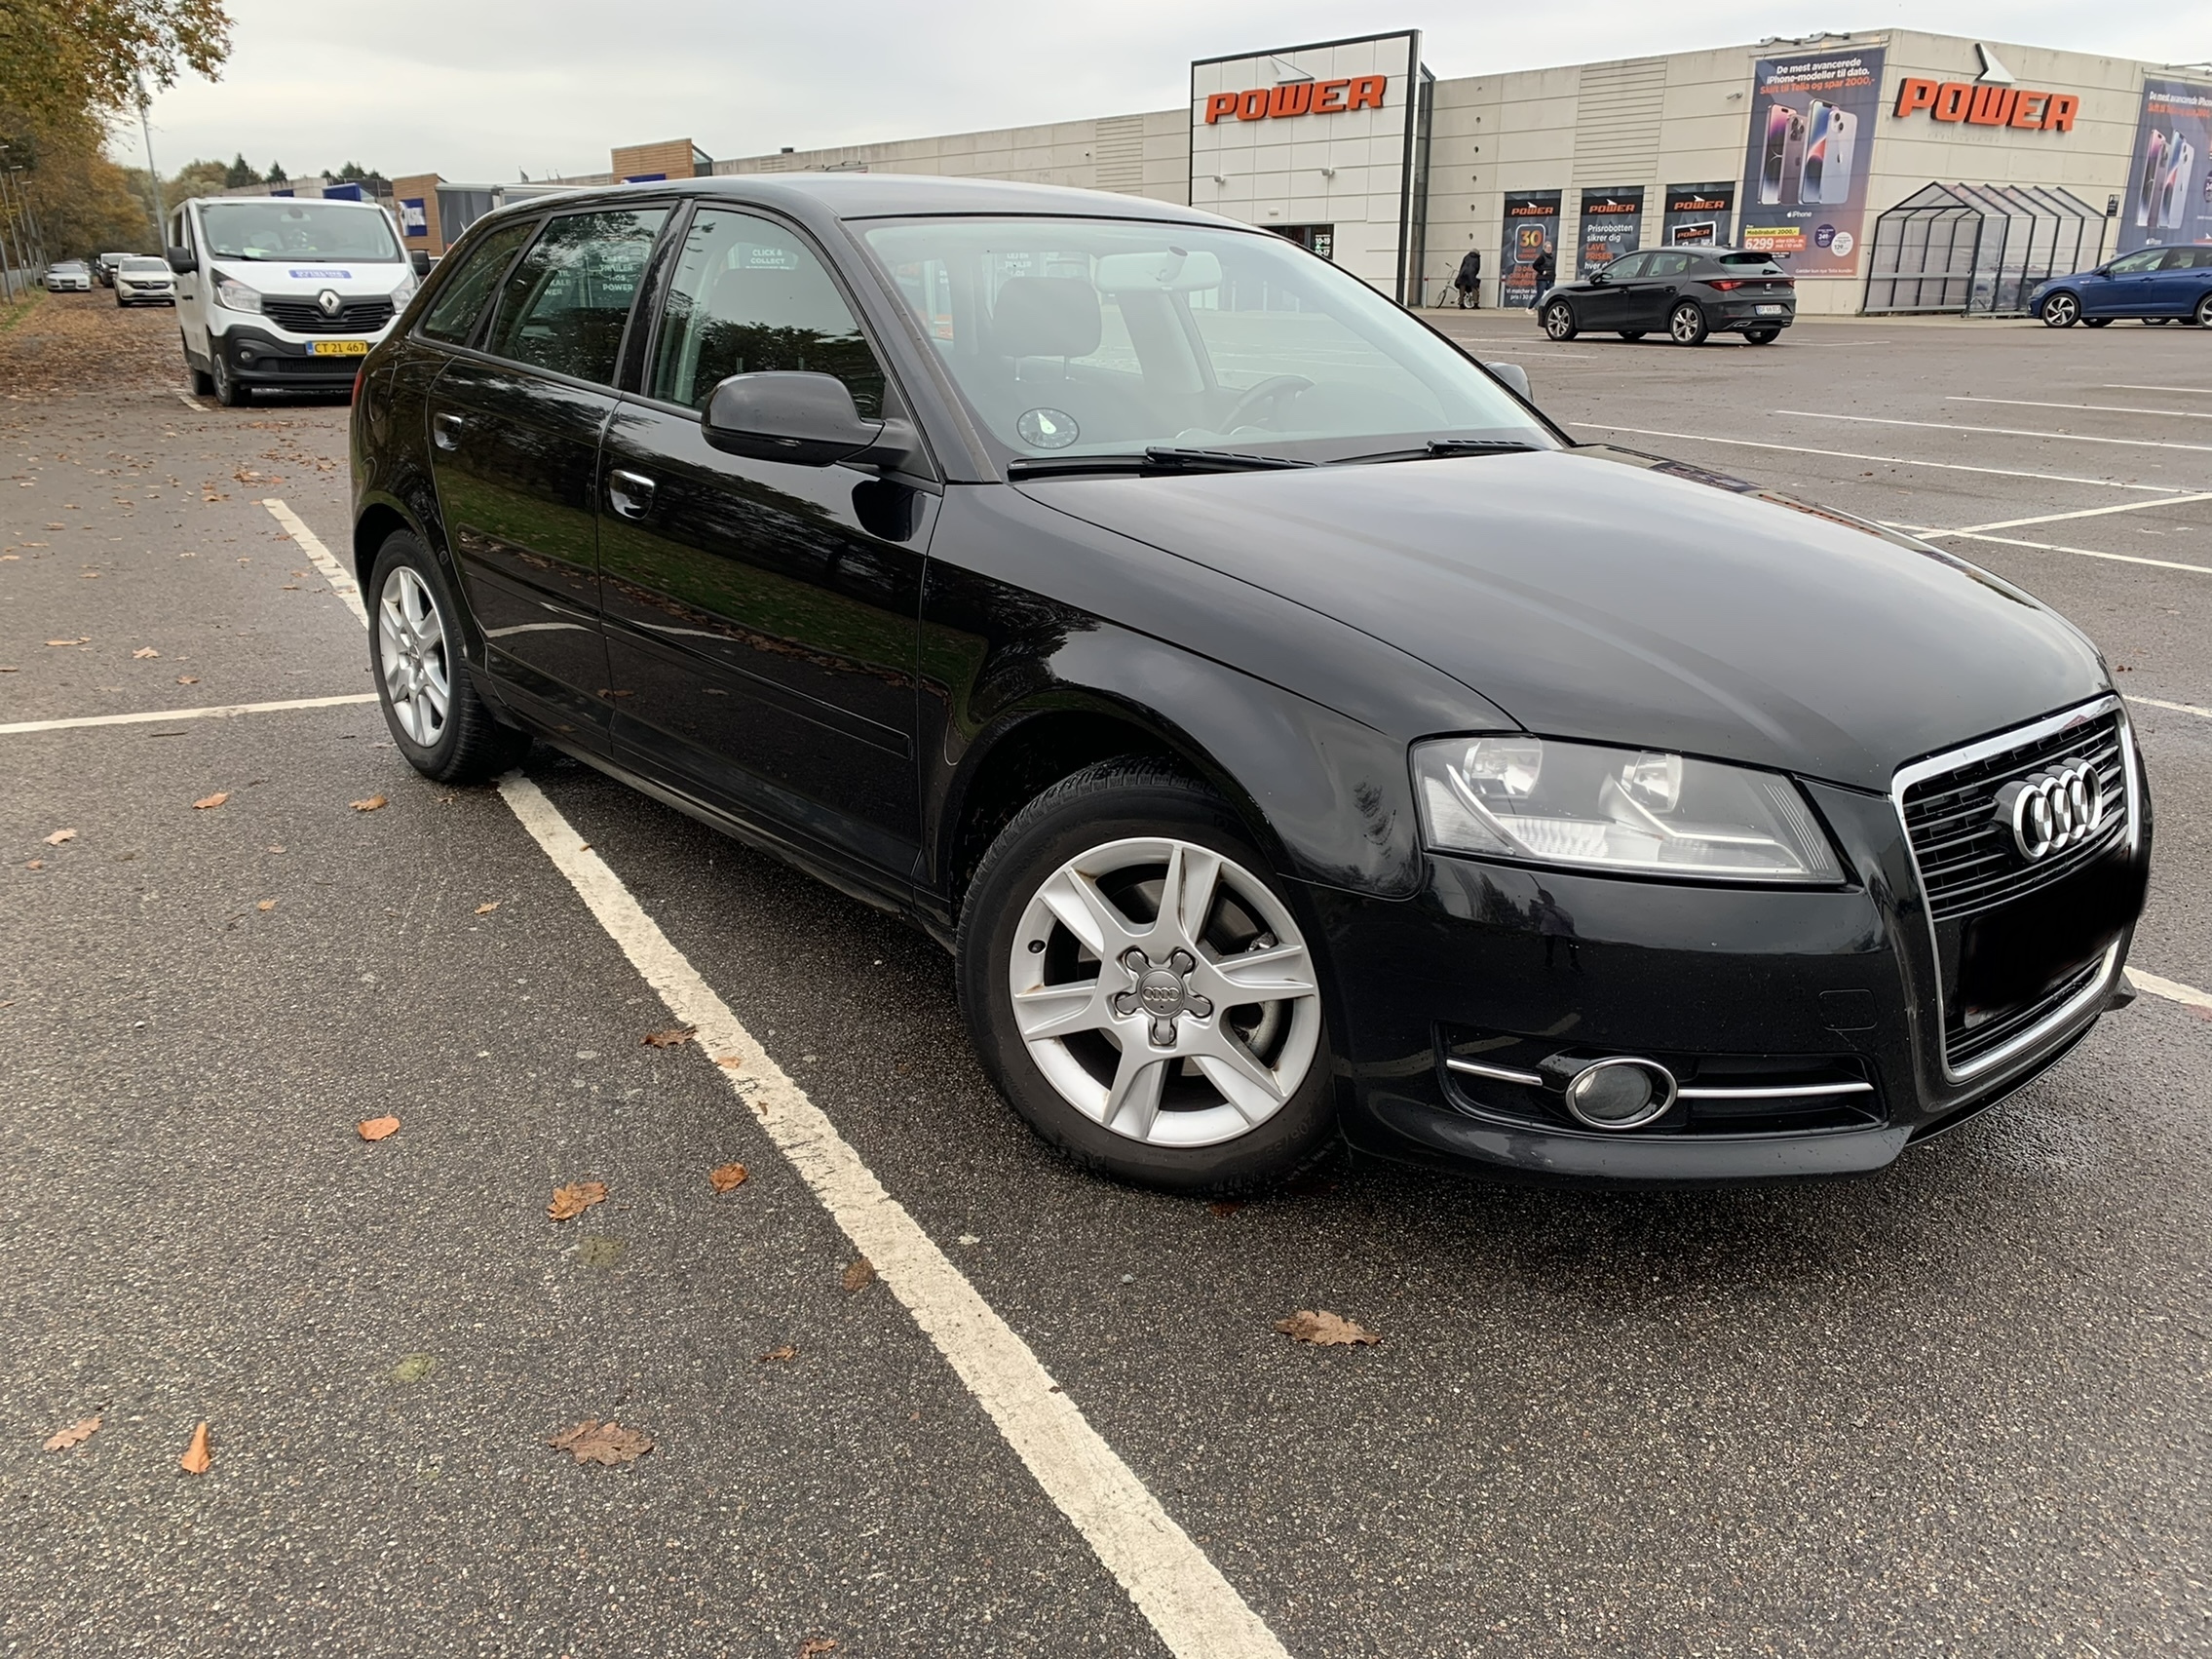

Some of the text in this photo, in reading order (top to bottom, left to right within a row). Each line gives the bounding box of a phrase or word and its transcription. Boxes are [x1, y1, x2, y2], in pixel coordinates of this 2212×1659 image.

[1776, 58, 1862, 74] De mest avancerede
[1767, 66, 1870, 84] iPhone-modeller til dato.
[1781, 84, 1790, 93] til
[1812, 82, 1823, 91] og
[1824, 80, 1844, 90] spar
[1845, 76, 1875, 87] 2000,-
[1205, 74, 1388, 124] POWER
[1893, 77, 2079, 132] POWER
[1511, 207, 1554, 215] POWER
[1588, 204, 1635, 213] POWER
[1673, 200, 1725, 211] POWER
[1519, 230, 1543, 248] 30
[1608, 233, 1621, 243] dig
[1677, 229, 1710, 239] POWER
[1745, 237, 1774, 250] 6299
[1583, 261, 1601, 270] hver
[314, 342, 365, 353] CT 21 467
